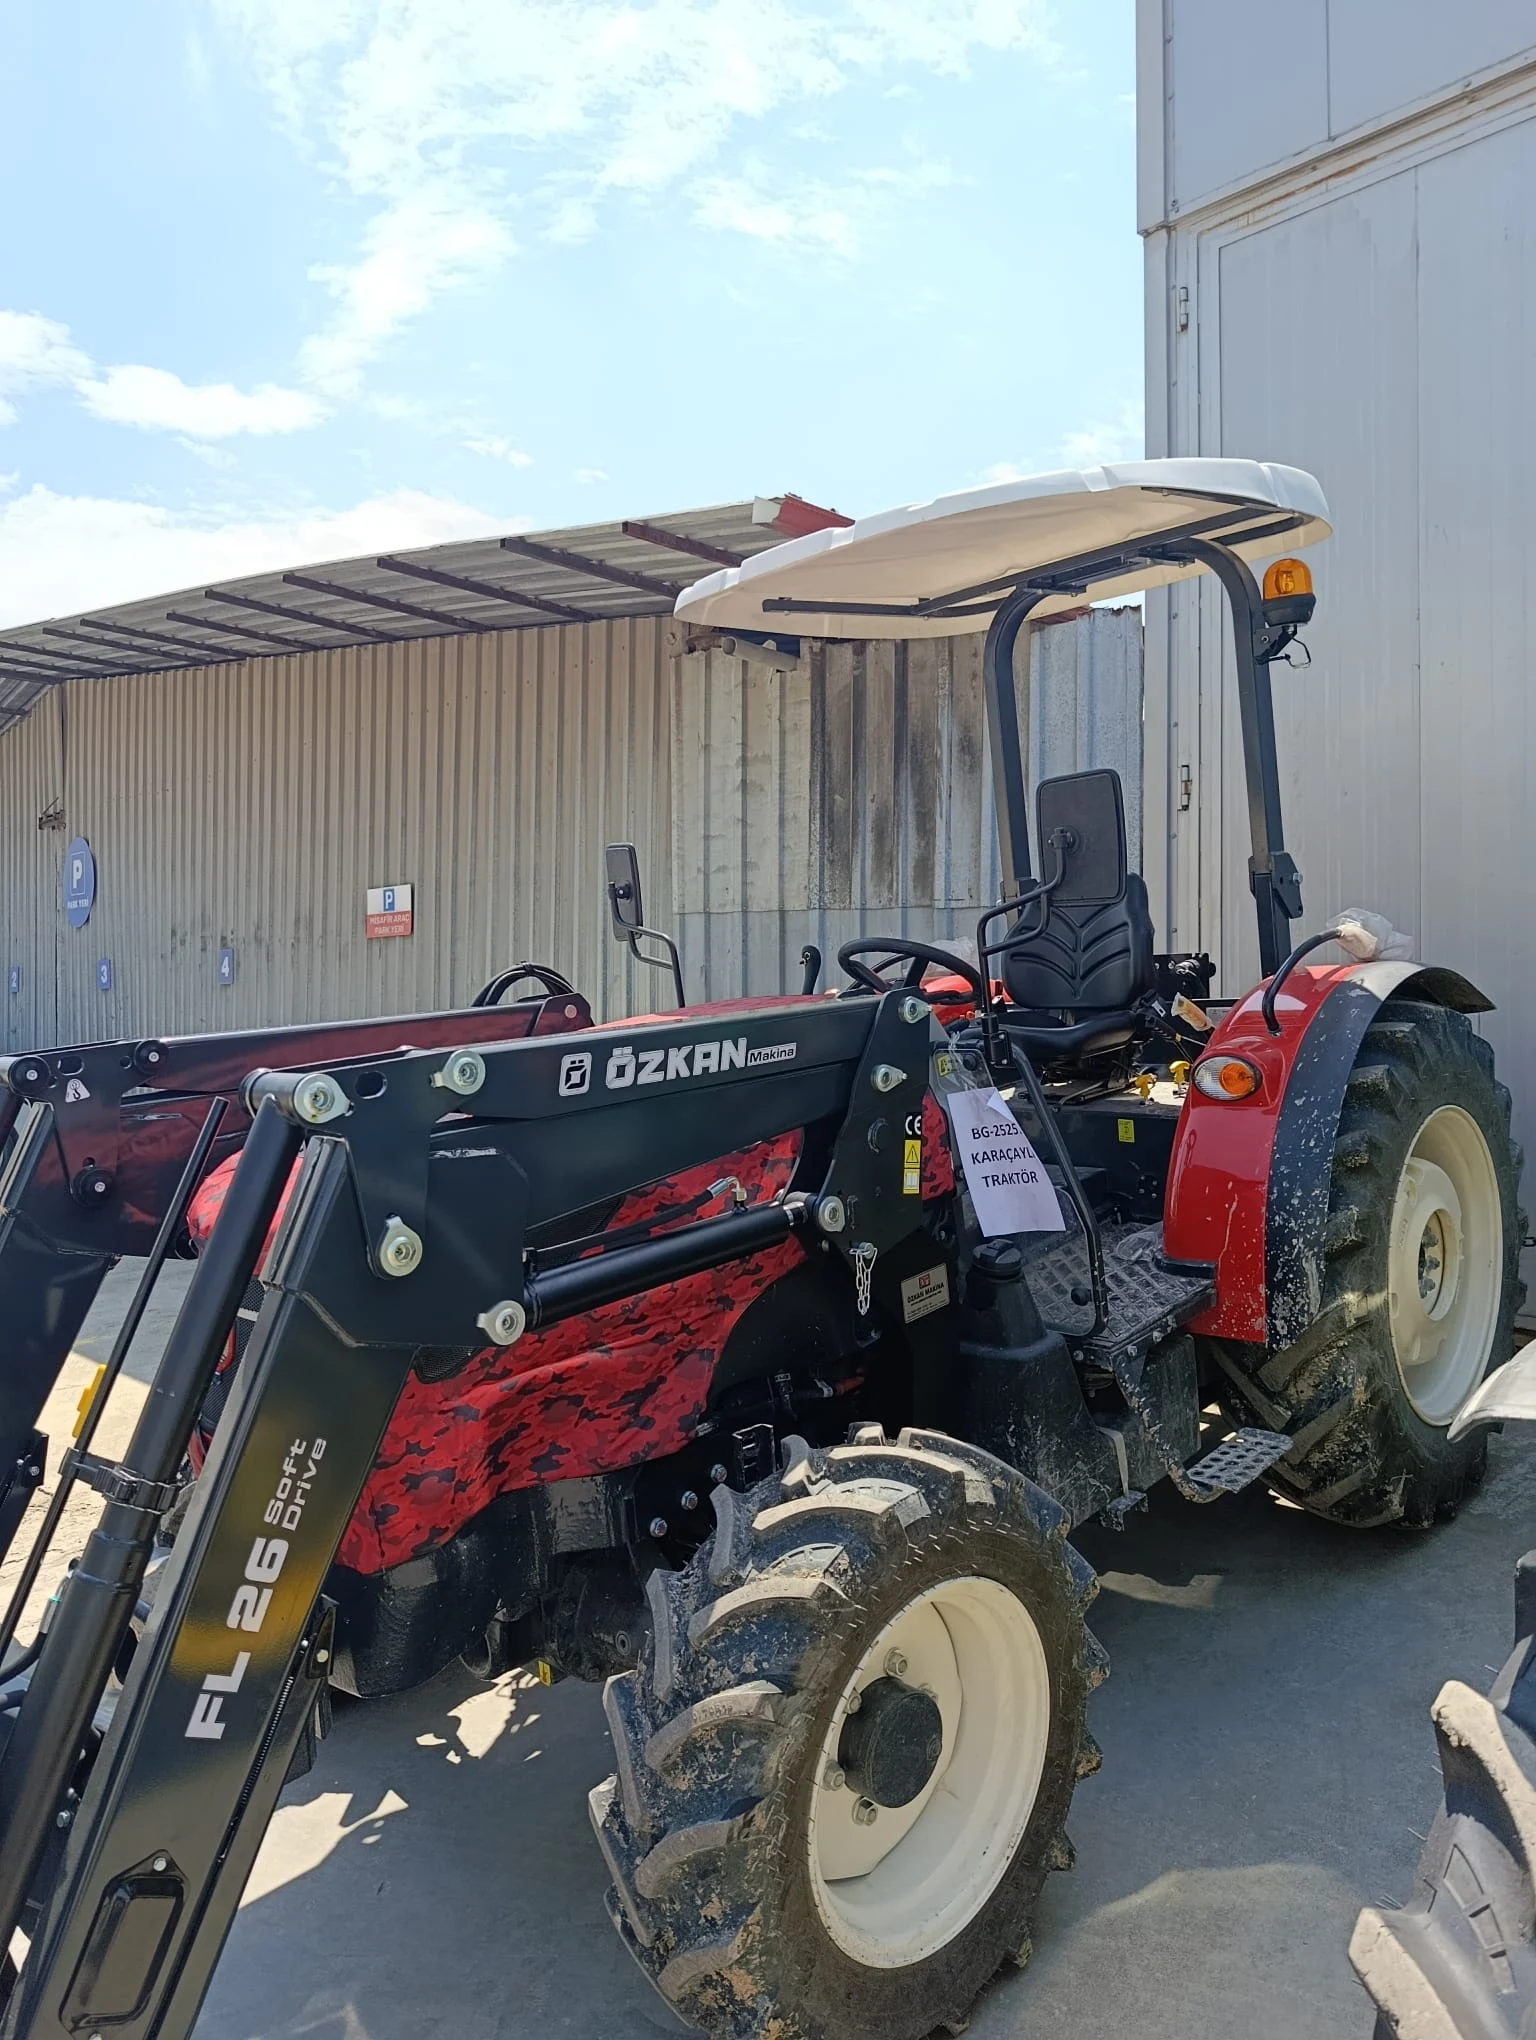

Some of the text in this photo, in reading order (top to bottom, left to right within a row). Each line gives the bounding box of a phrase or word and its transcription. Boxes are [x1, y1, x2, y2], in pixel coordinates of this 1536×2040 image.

[72, 859, 83, 889] P
[385, 891, 393, 909] P
[393, 913, 410, 924] ARAÇ
[374, 926, 389, 935] PARK
[100, 965, 107, 983] 3
[220, 956, 229, 977] 4
[11, 971, 17, 987] 2
[605, 1037, 748, 1089] ÖZKAN
[748, 1046, 795, 1065] Makina
[905, 1115, 922, 1136] CE
[981, 1168, 1039, 1188] TRAKTÖR
[264, 1438, 306, 1525] Soft
[282, 1438, 327, 1531] Drive
[184, 1536, 289, 1740] FL 26
